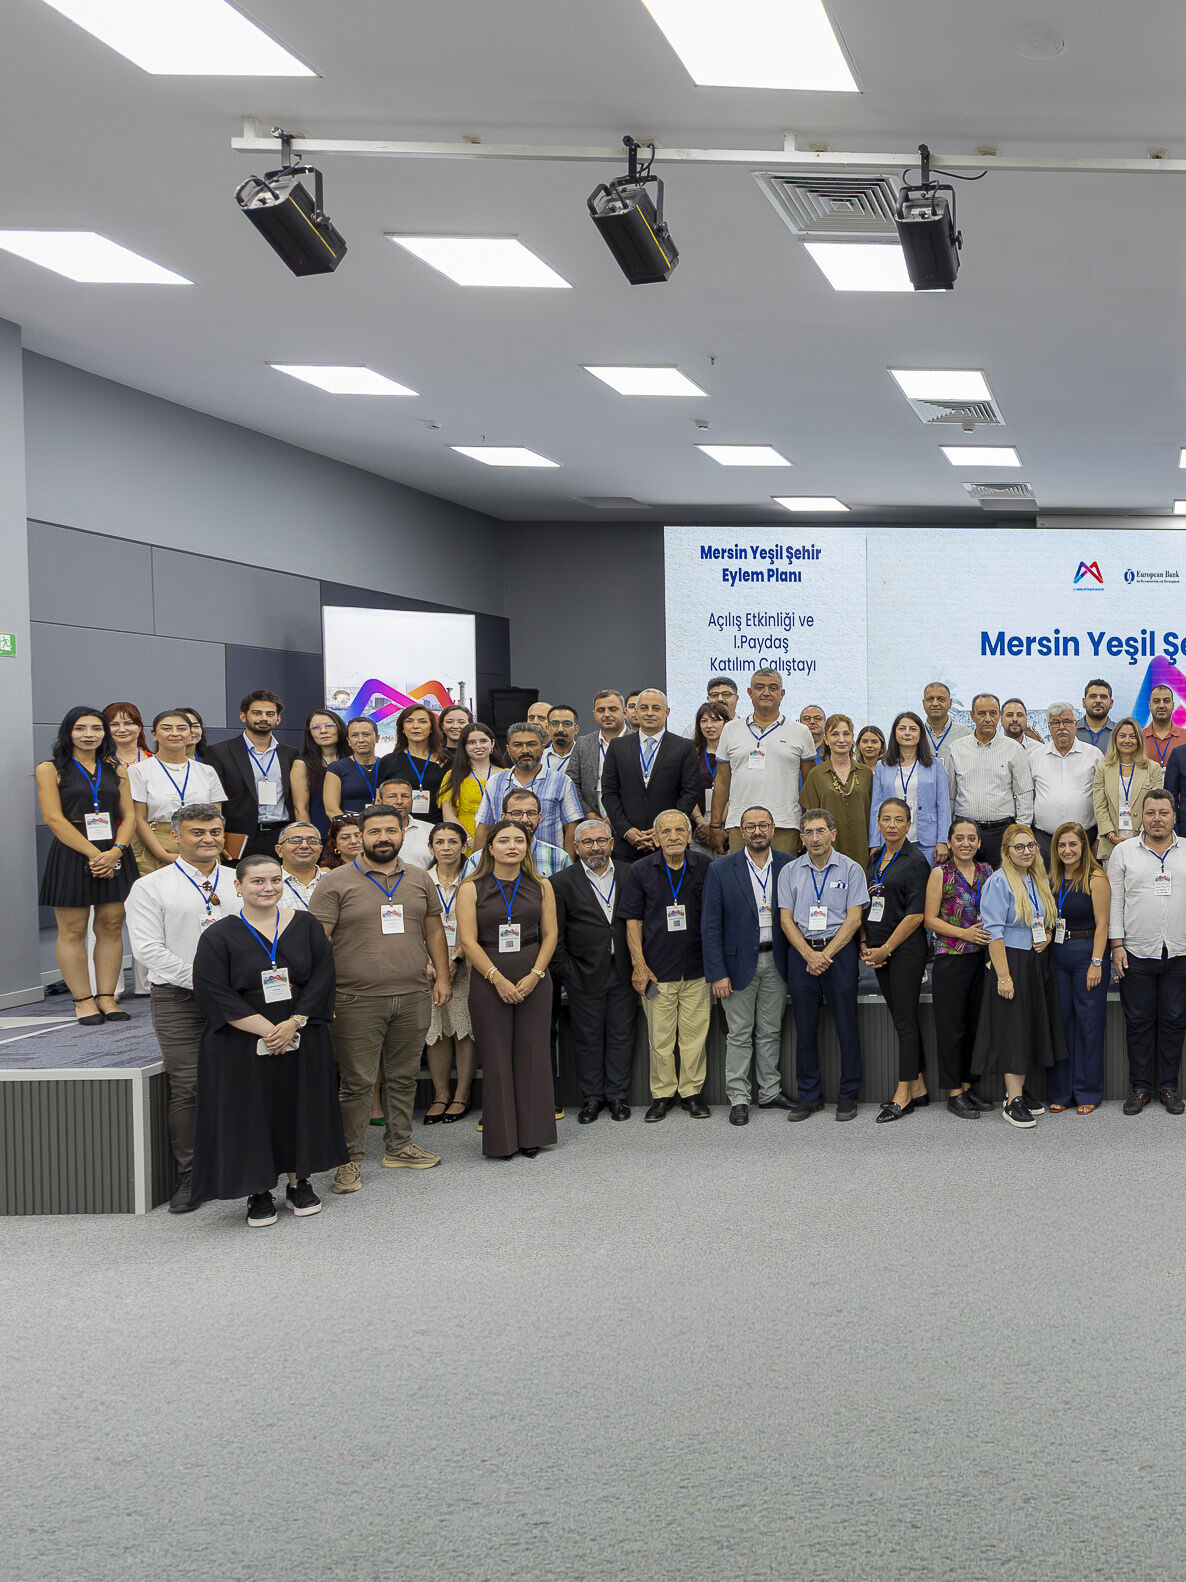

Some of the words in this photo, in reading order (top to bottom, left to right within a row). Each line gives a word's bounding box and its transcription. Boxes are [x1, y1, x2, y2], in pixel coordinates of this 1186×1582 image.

[700, 544, 747, 560] Mersin
[750, 544, 783, 564] Yeşil
[786, 544, 822, 564] Şehir
[722, 568, 764, 587] Eylem
[767, 568, 802, 583] Planı
[1136, 570, 1163, 579] European
[1165, 570, 1180, 578] Bank
[708, 612, 742, 631] Açılış
[746, 612, 795, 632] Etkinliği
[799, 615, 815, 627] ve
[733, 635, 789, 654] I.Paydaş
[980, 629, 1080, 657] Mersin
[1087, 629, 1156, 665] Yeşil
[710, 657, 756, 672] Katılım
